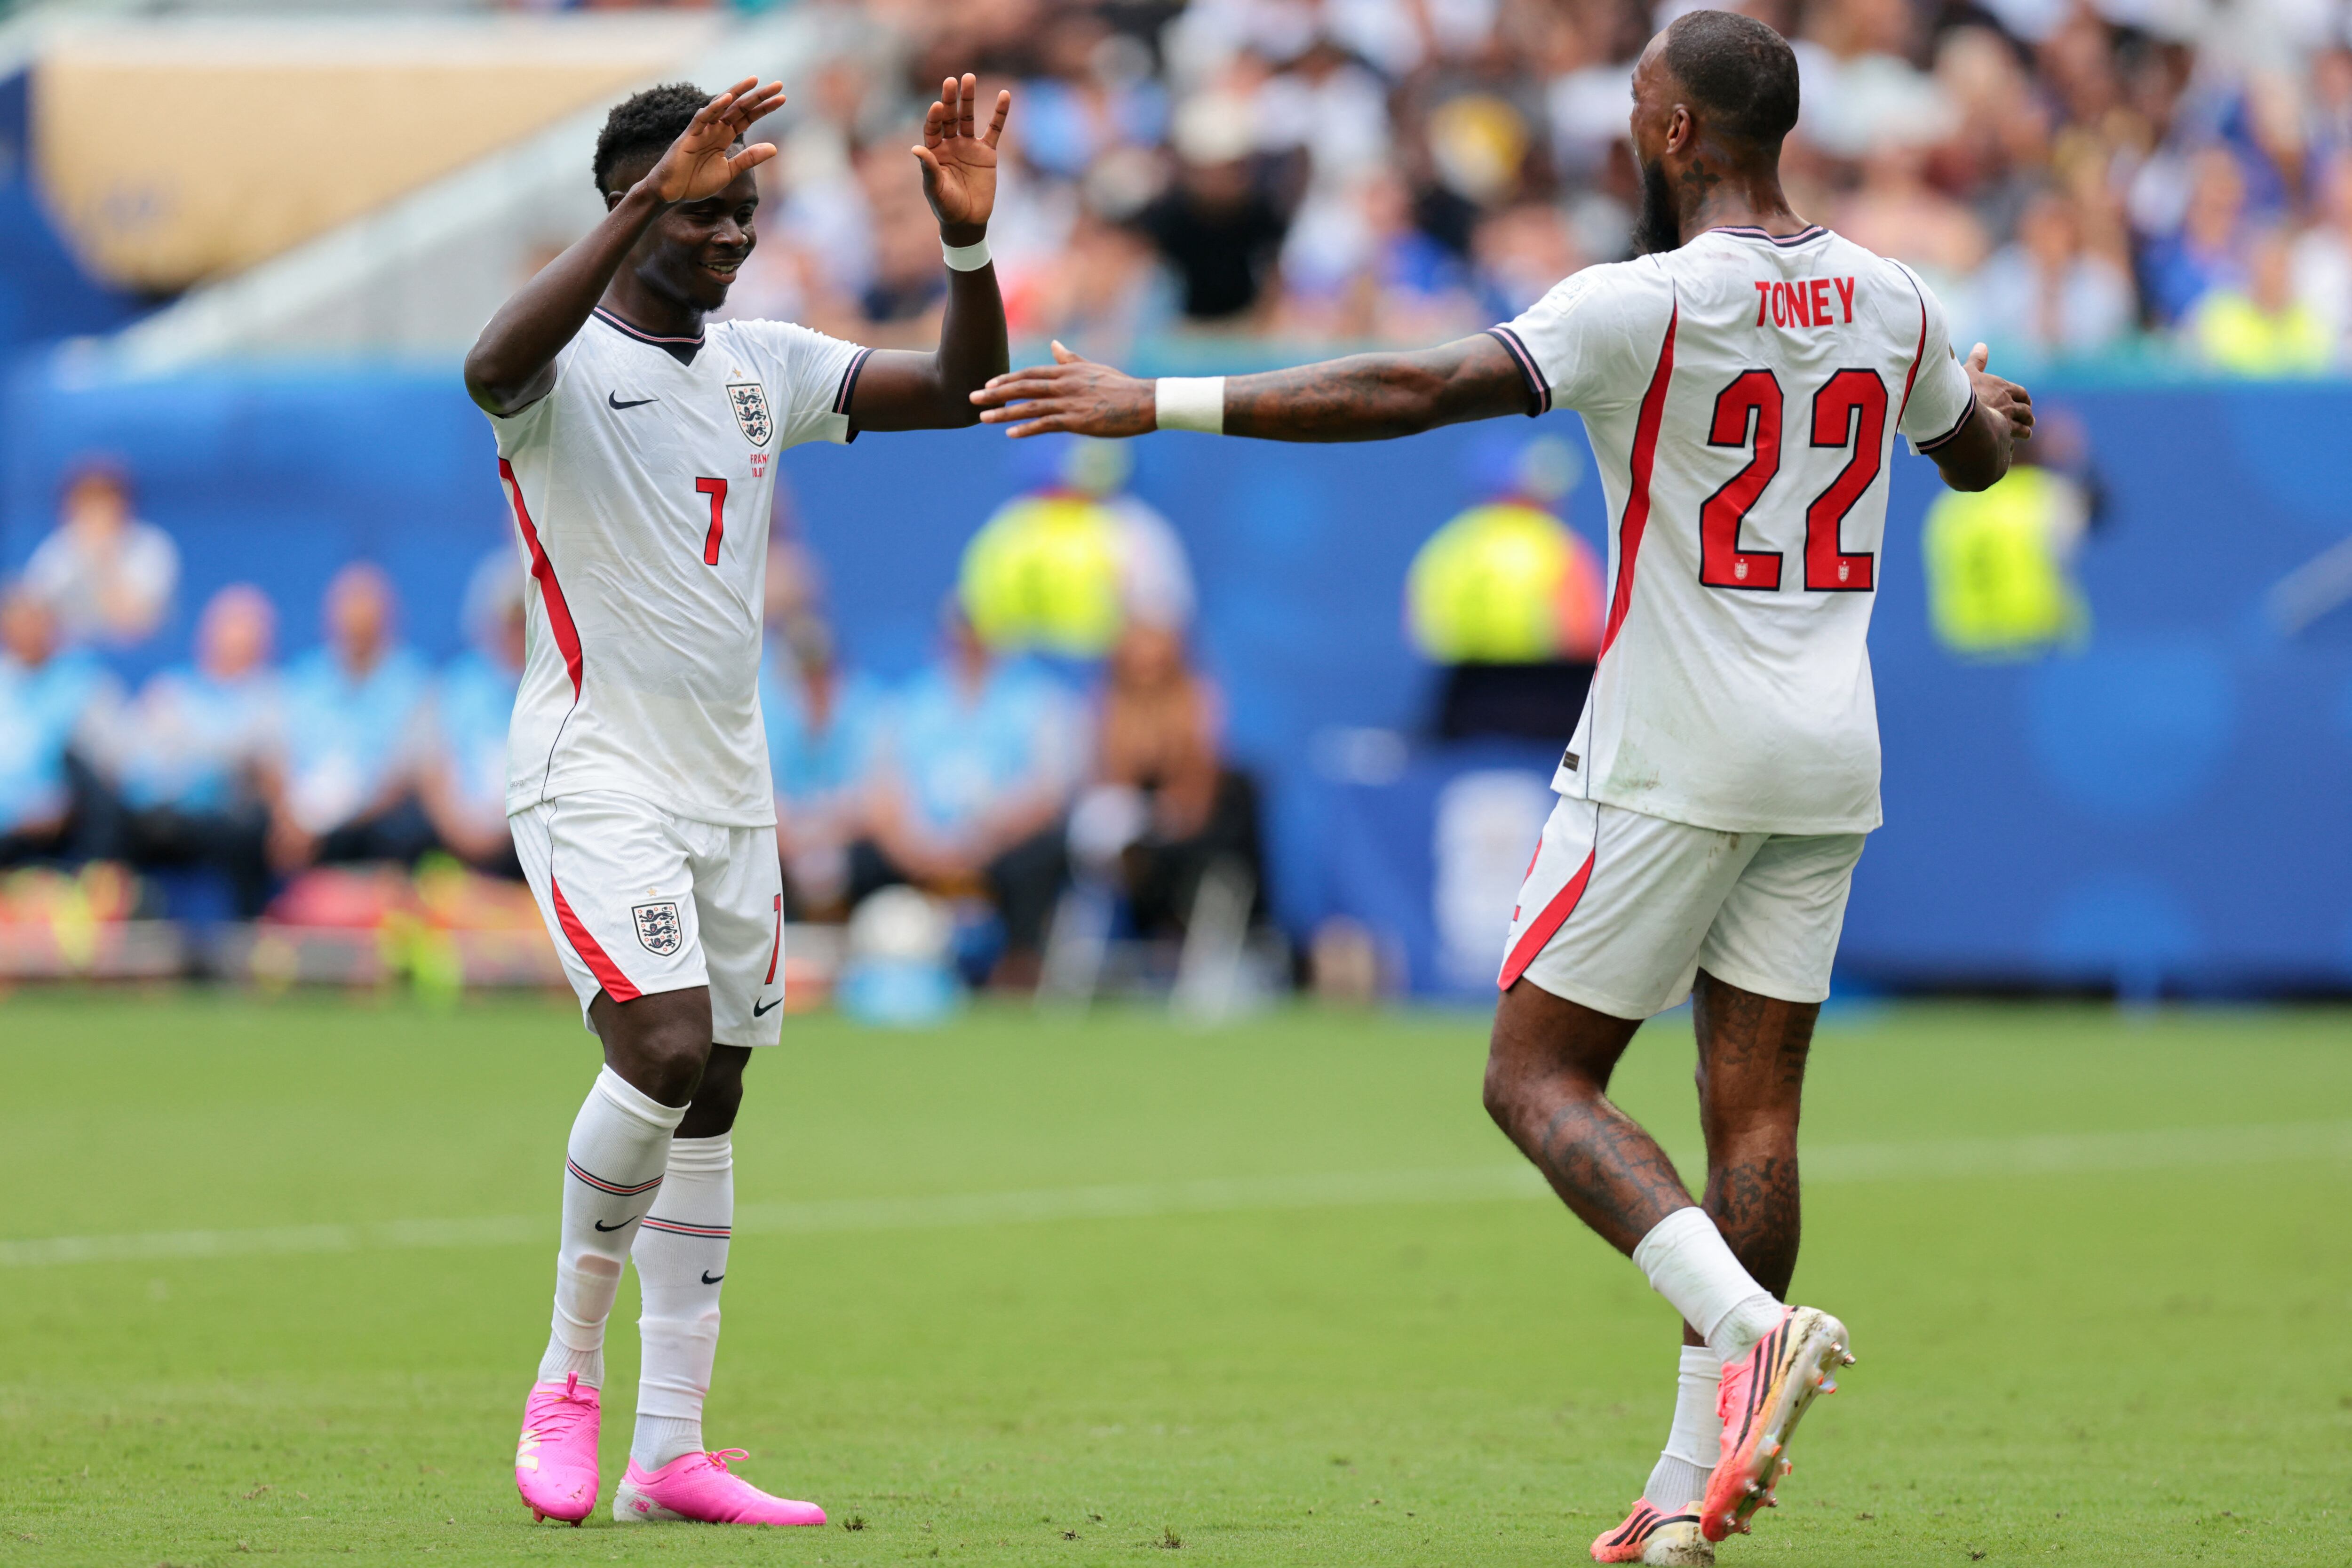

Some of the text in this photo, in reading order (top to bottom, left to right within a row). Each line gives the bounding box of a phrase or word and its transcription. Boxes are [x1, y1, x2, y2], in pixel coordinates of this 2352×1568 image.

[1755, 276, 1854, 328] TONEY
[696, 477, 727, 565] 7
[1699, 368, 1888, 591] 22
[764, 893, 781, 985] 7
